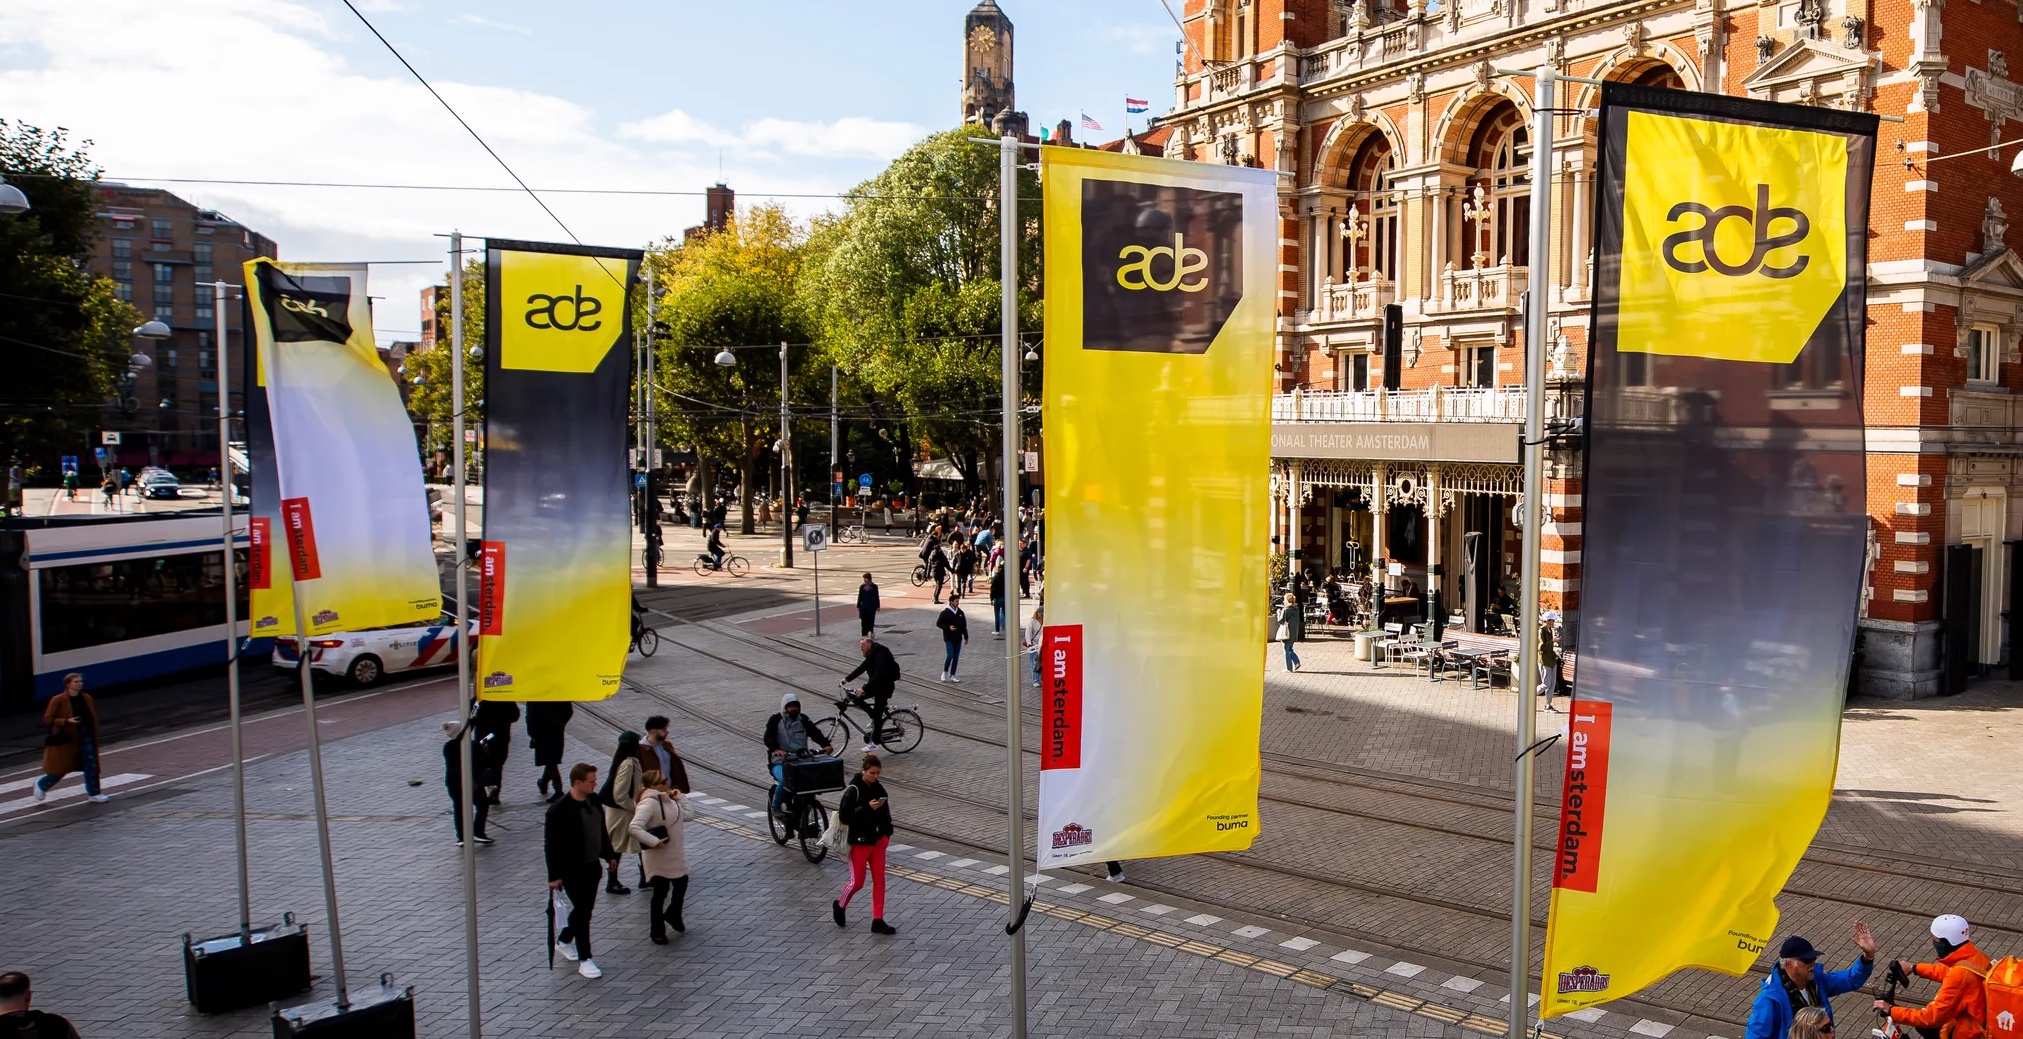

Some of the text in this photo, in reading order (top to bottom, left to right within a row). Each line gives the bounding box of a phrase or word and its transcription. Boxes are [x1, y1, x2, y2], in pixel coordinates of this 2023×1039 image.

[1271, 434, 1430, 450] ONAAL THEATER AMSTERDAM
[1054, 635, 1071, 643] I
[1574, 714, 1596, 724] I
[1216, 820, 1249, 831] buma
[1728, 929, 1758, 942] Founding
[1559, 973, 1610, 992] DESPERADOS
